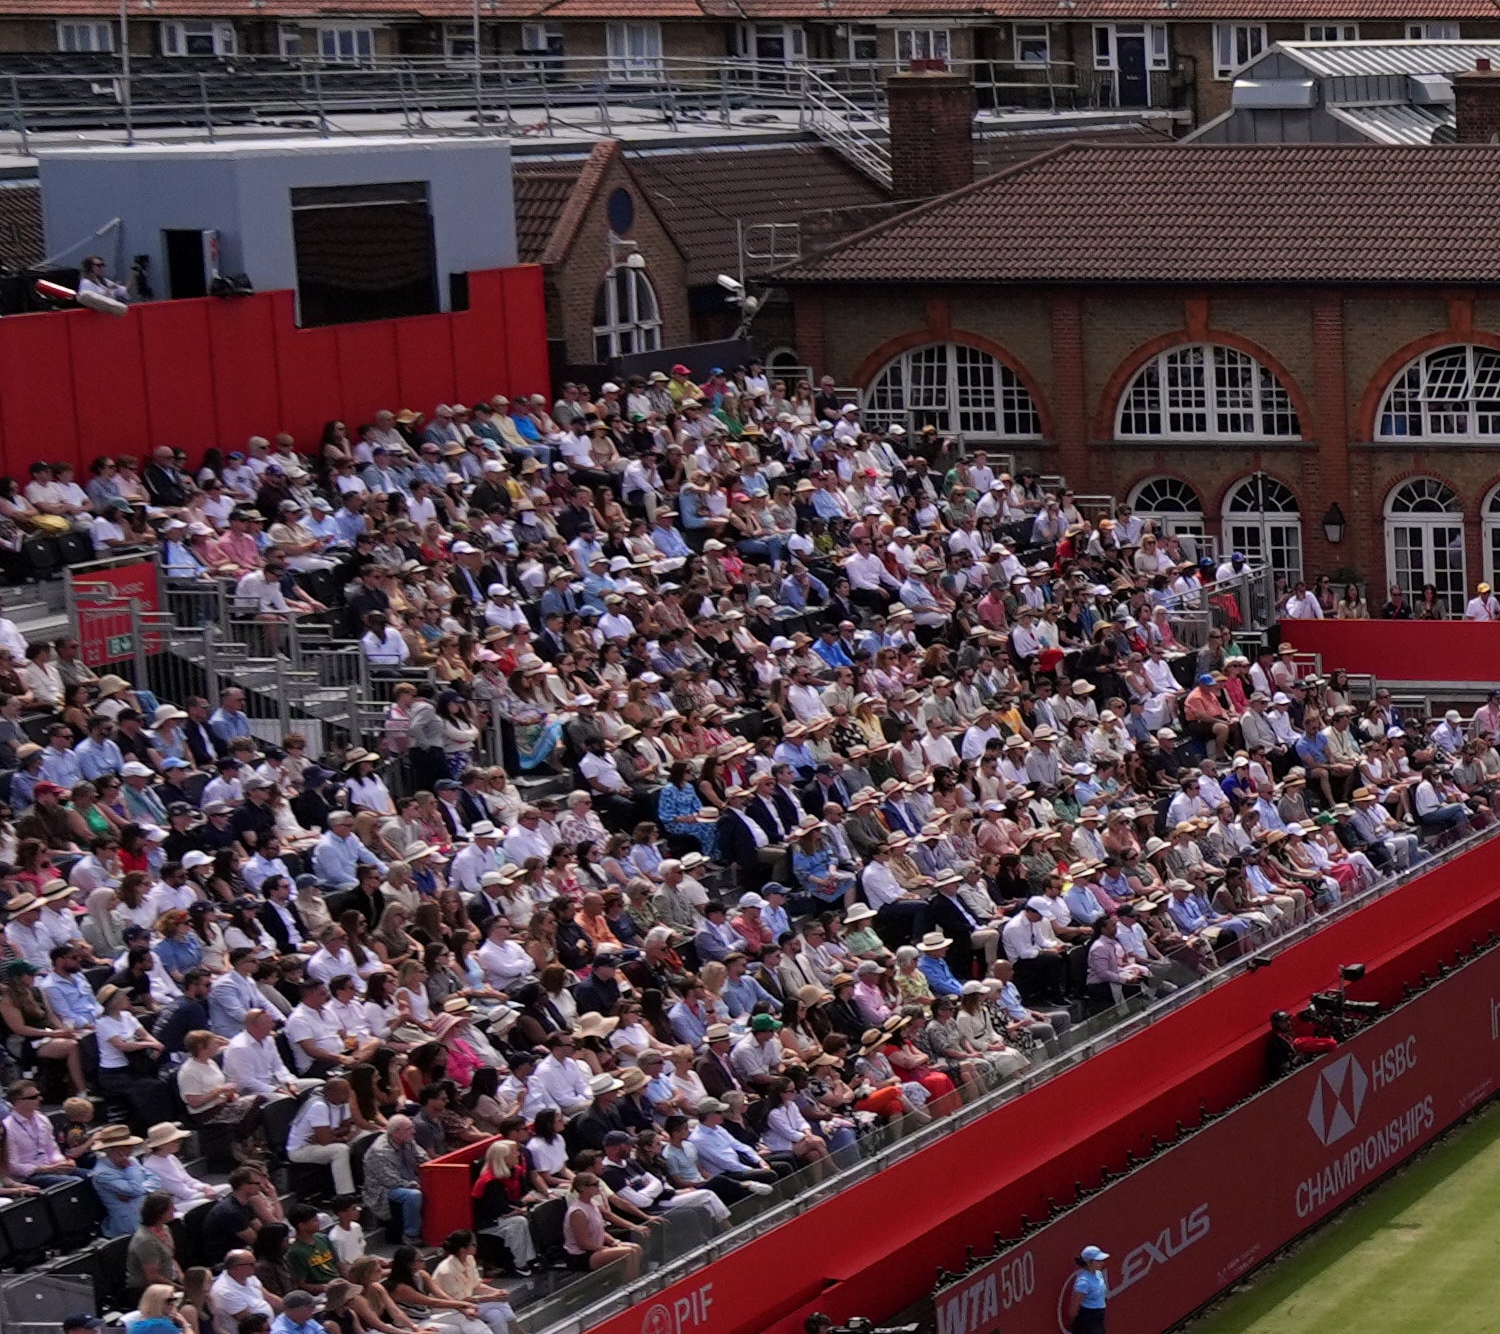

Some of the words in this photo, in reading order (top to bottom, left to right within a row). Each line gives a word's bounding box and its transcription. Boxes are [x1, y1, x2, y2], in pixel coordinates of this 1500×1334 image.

[1370, 1034, 1418, 1094] HSBC
[1295, 1094, 1435, 1219] CHAMPIONSHIPS
[1001, 1249, 1036, 1310] 500
